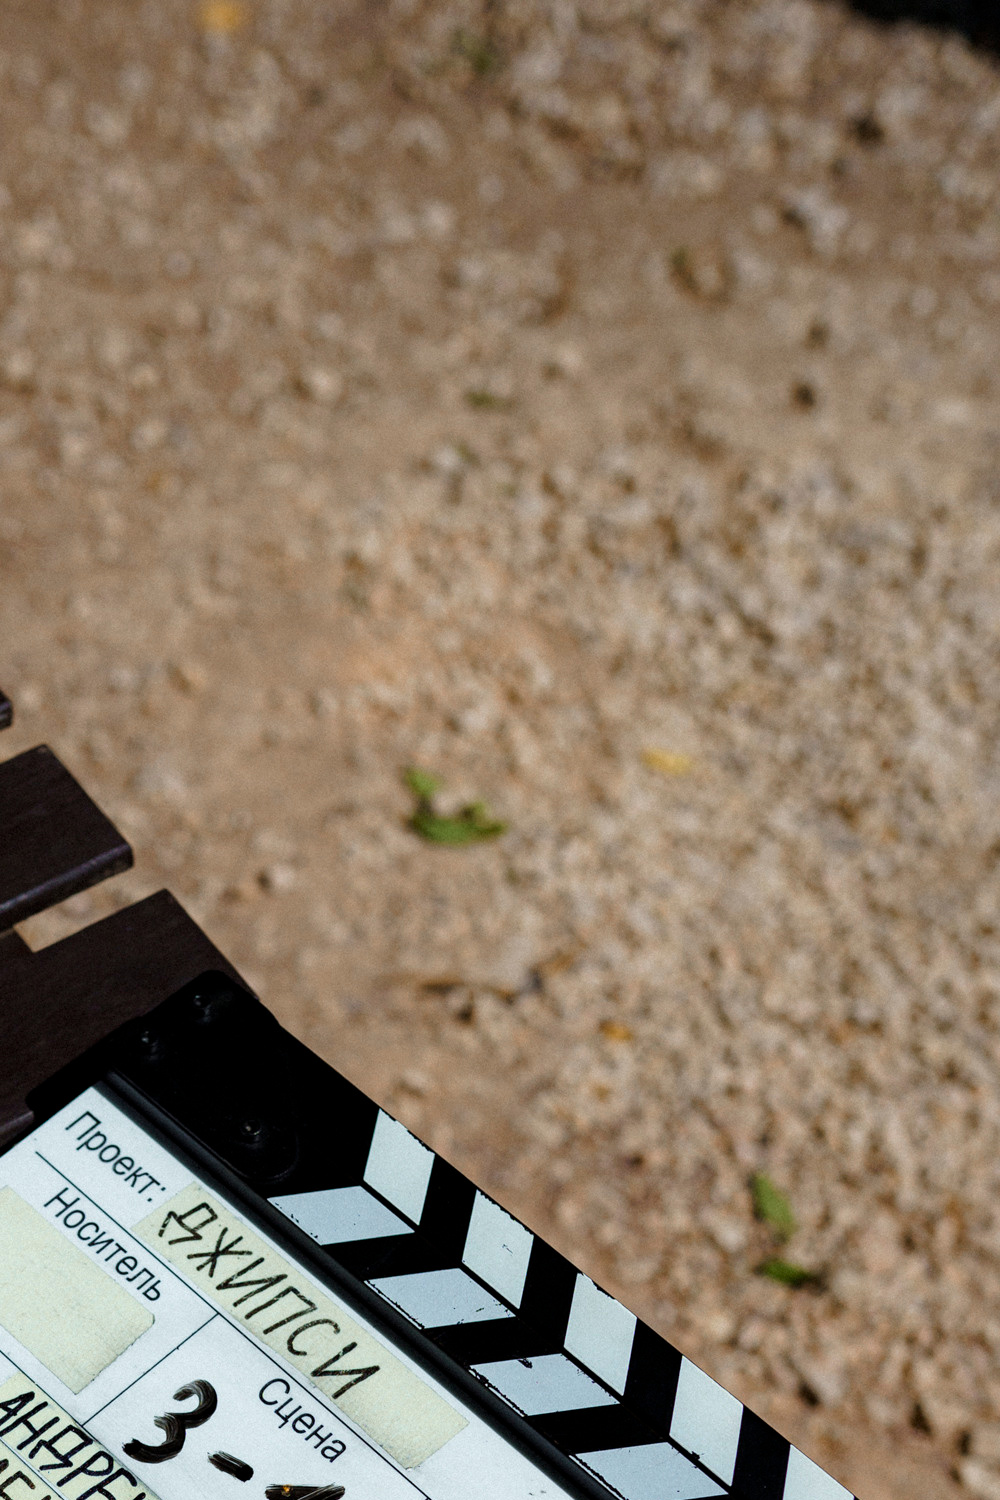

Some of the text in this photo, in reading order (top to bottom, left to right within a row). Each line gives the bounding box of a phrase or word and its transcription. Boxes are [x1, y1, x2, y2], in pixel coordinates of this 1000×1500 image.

[64, 1110, 167, 1203] Проект:
[44, 1187, 162, 1302] Носитель
[157, 1201, 380, 1399] ДЖИПСИ
[258, 1377, 347, 1463] Сцена
